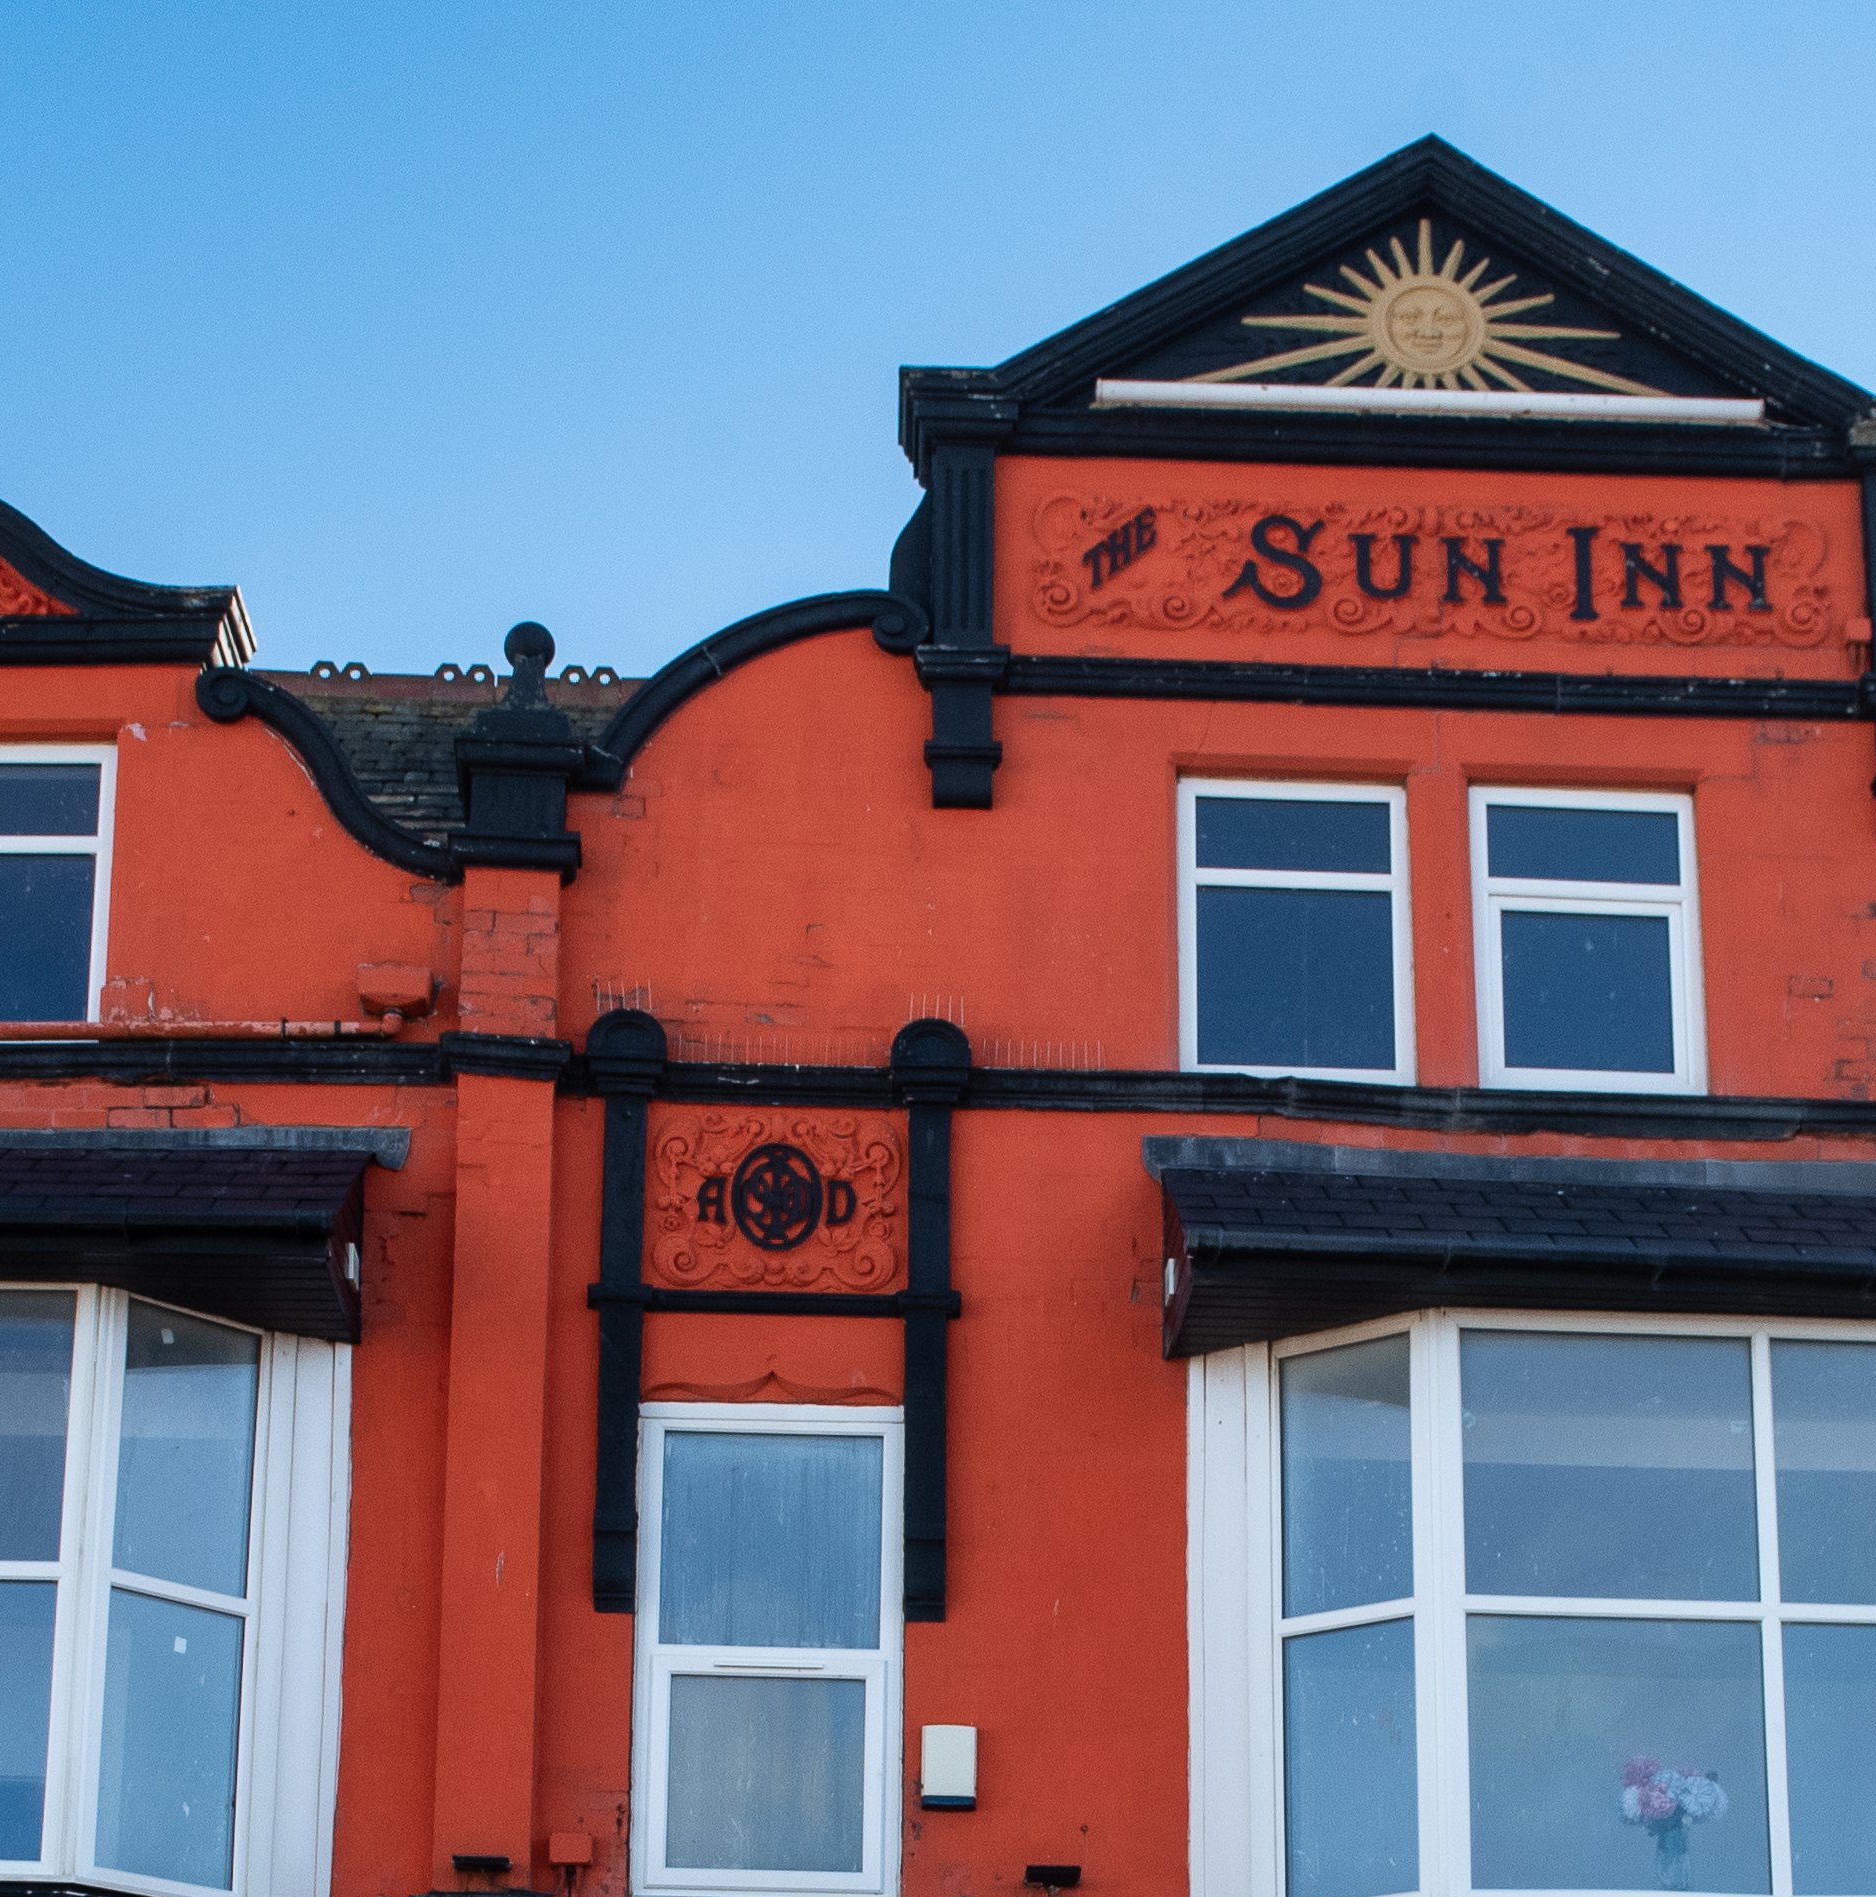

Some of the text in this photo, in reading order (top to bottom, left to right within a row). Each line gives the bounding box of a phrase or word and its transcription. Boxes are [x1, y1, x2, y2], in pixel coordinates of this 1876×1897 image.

[1080, 507, 1776, 621] THE SUN INN
